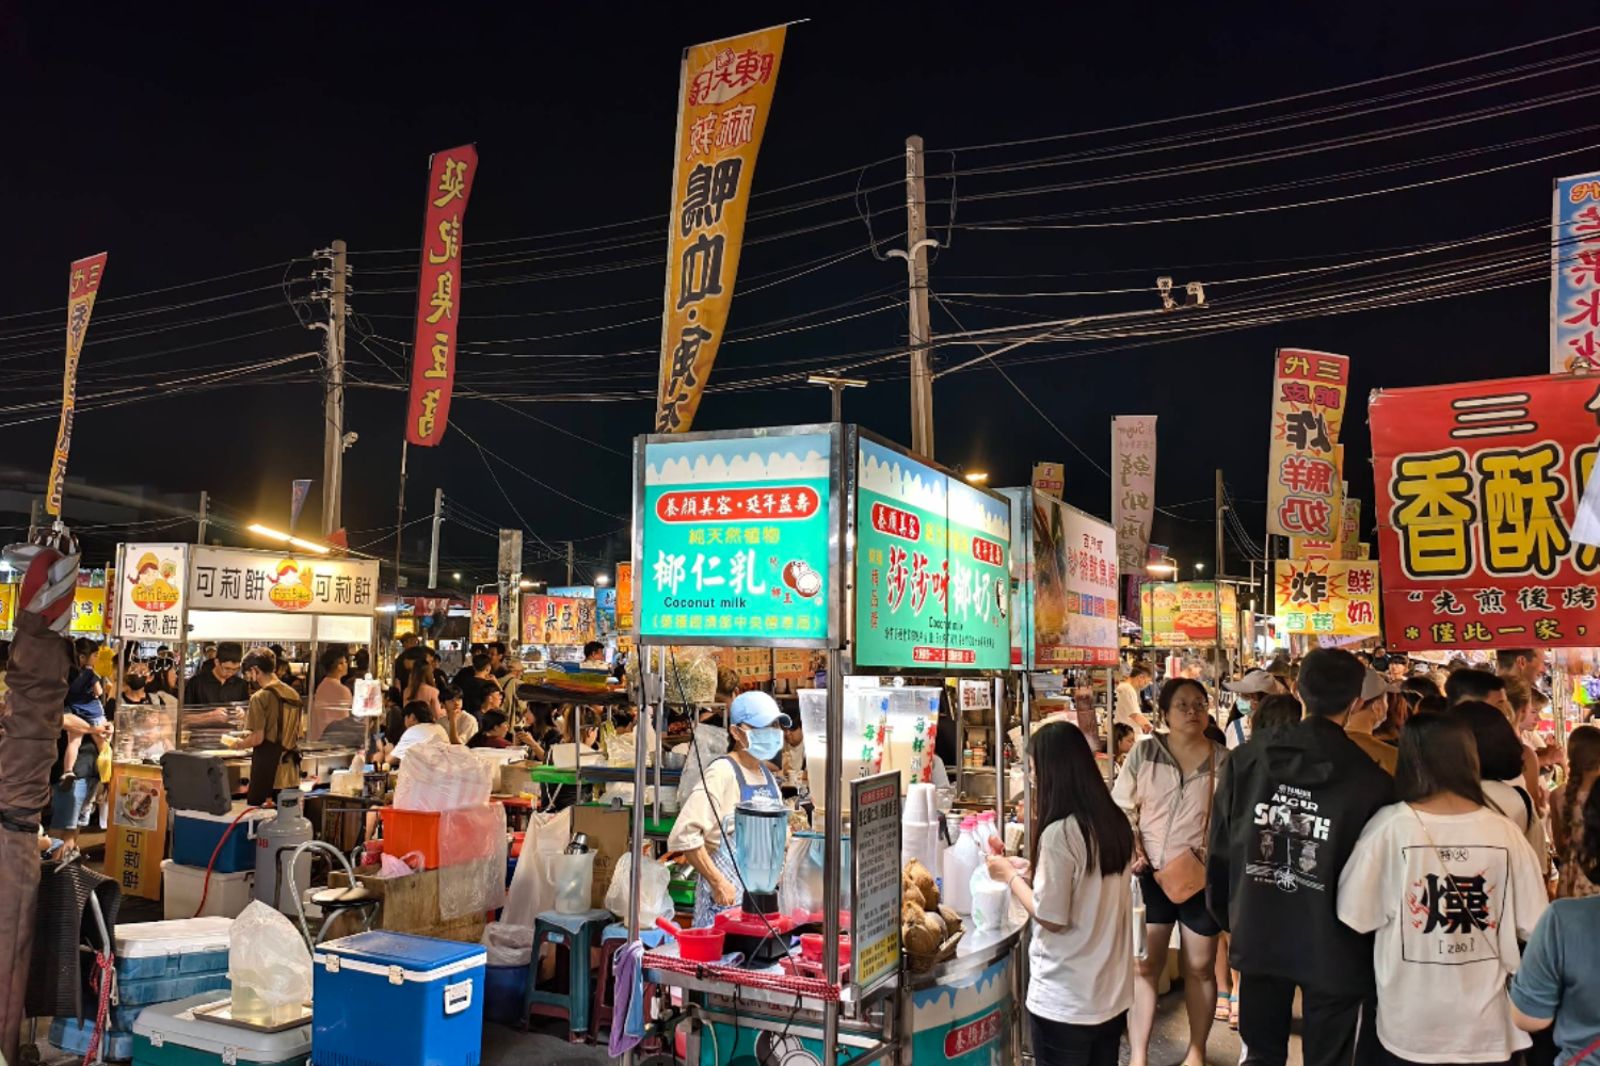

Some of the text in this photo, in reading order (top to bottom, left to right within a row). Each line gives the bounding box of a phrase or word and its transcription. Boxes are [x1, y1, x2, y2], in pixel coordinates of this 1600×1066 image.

[196, 566, 265, 602] 可莉餅
[653, 548, 766, 596] 椰仁乳
[1291, 571, 1328, 603] 炸
[315, 573, 372, 605] 可莉餅
[664, 596, 746, 609] Coconut milk
[1347, 569, 1375, 625] 鮮奶
[1285, 612, 1335, 630] 香蕉
